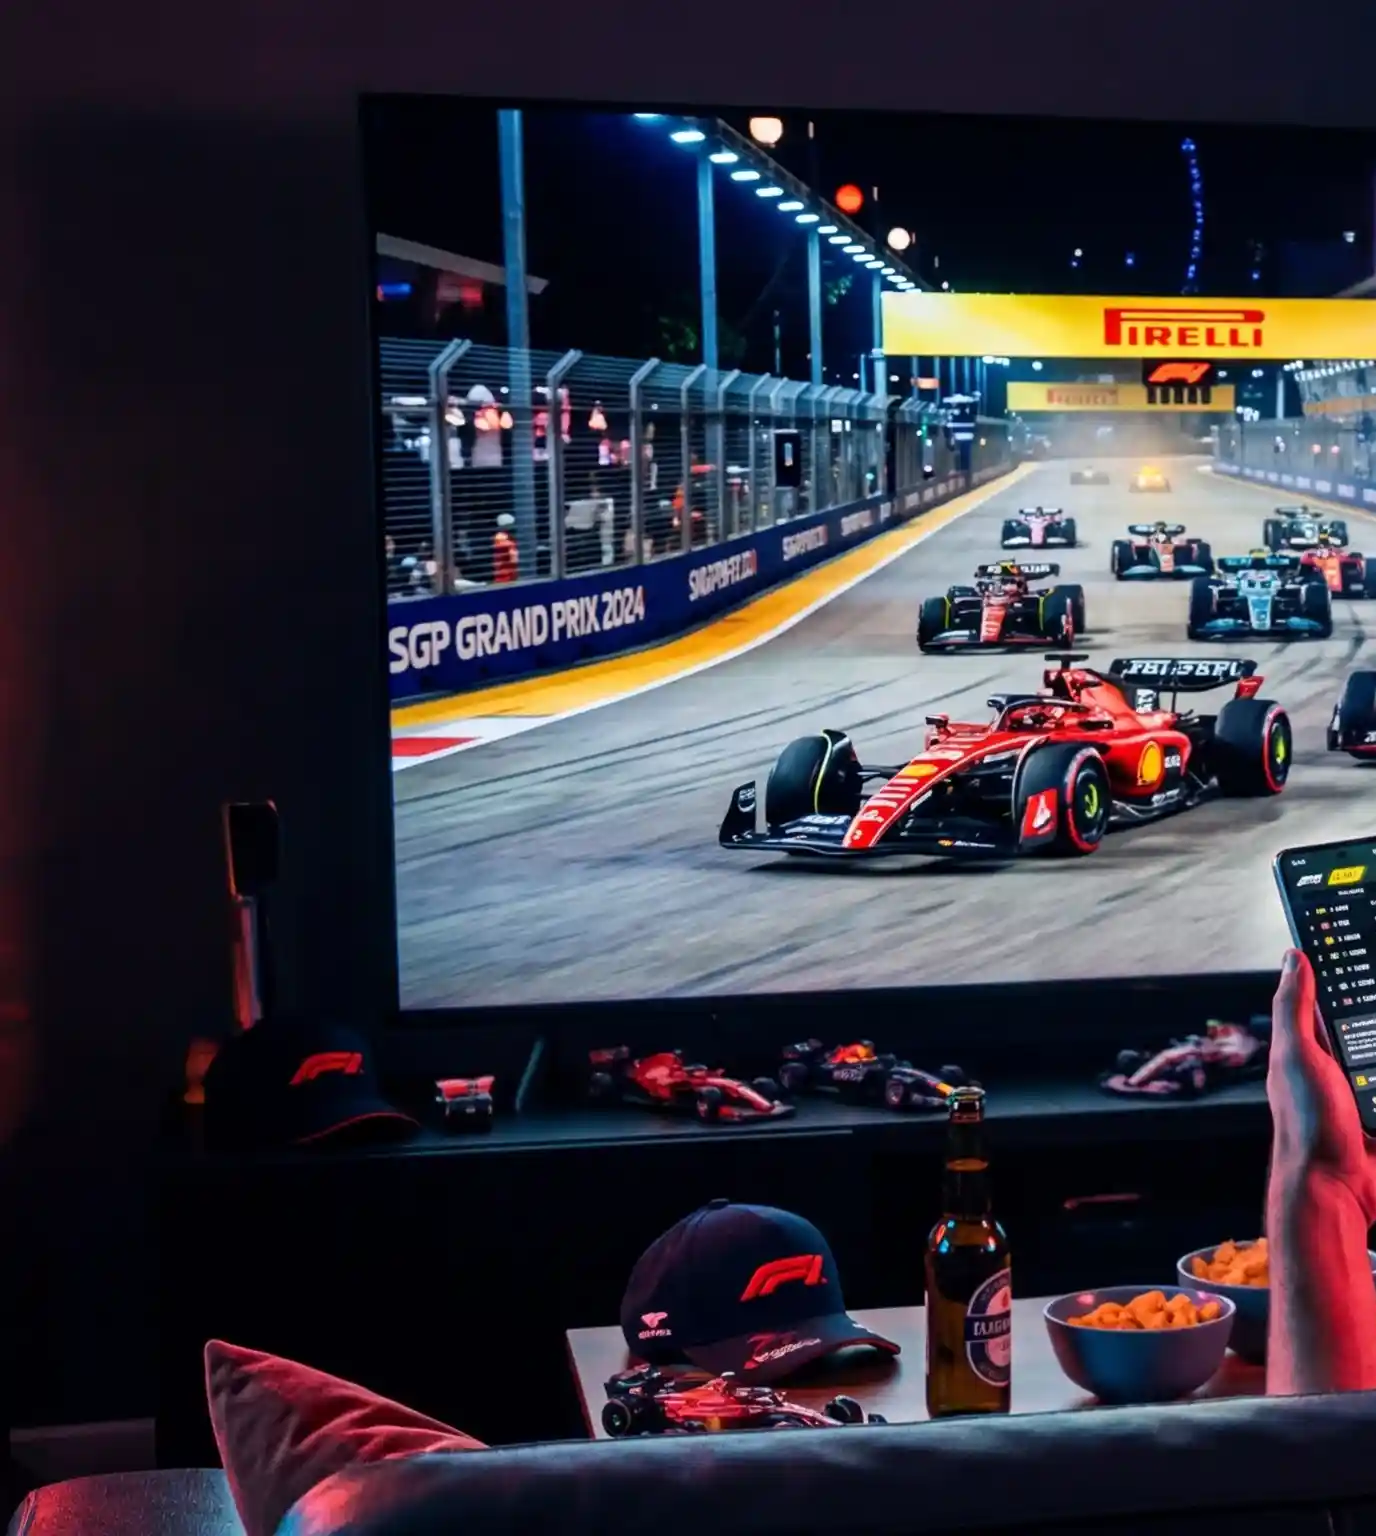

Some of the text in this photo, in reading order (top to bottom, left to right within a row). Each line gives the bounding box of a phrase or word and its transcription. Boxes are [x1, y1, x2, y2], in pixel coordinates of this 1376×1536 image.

[1104, 308, 1265, 347] PIRELLI
[388, 585, 646, 674] SGP GRAND PRIX 2024
